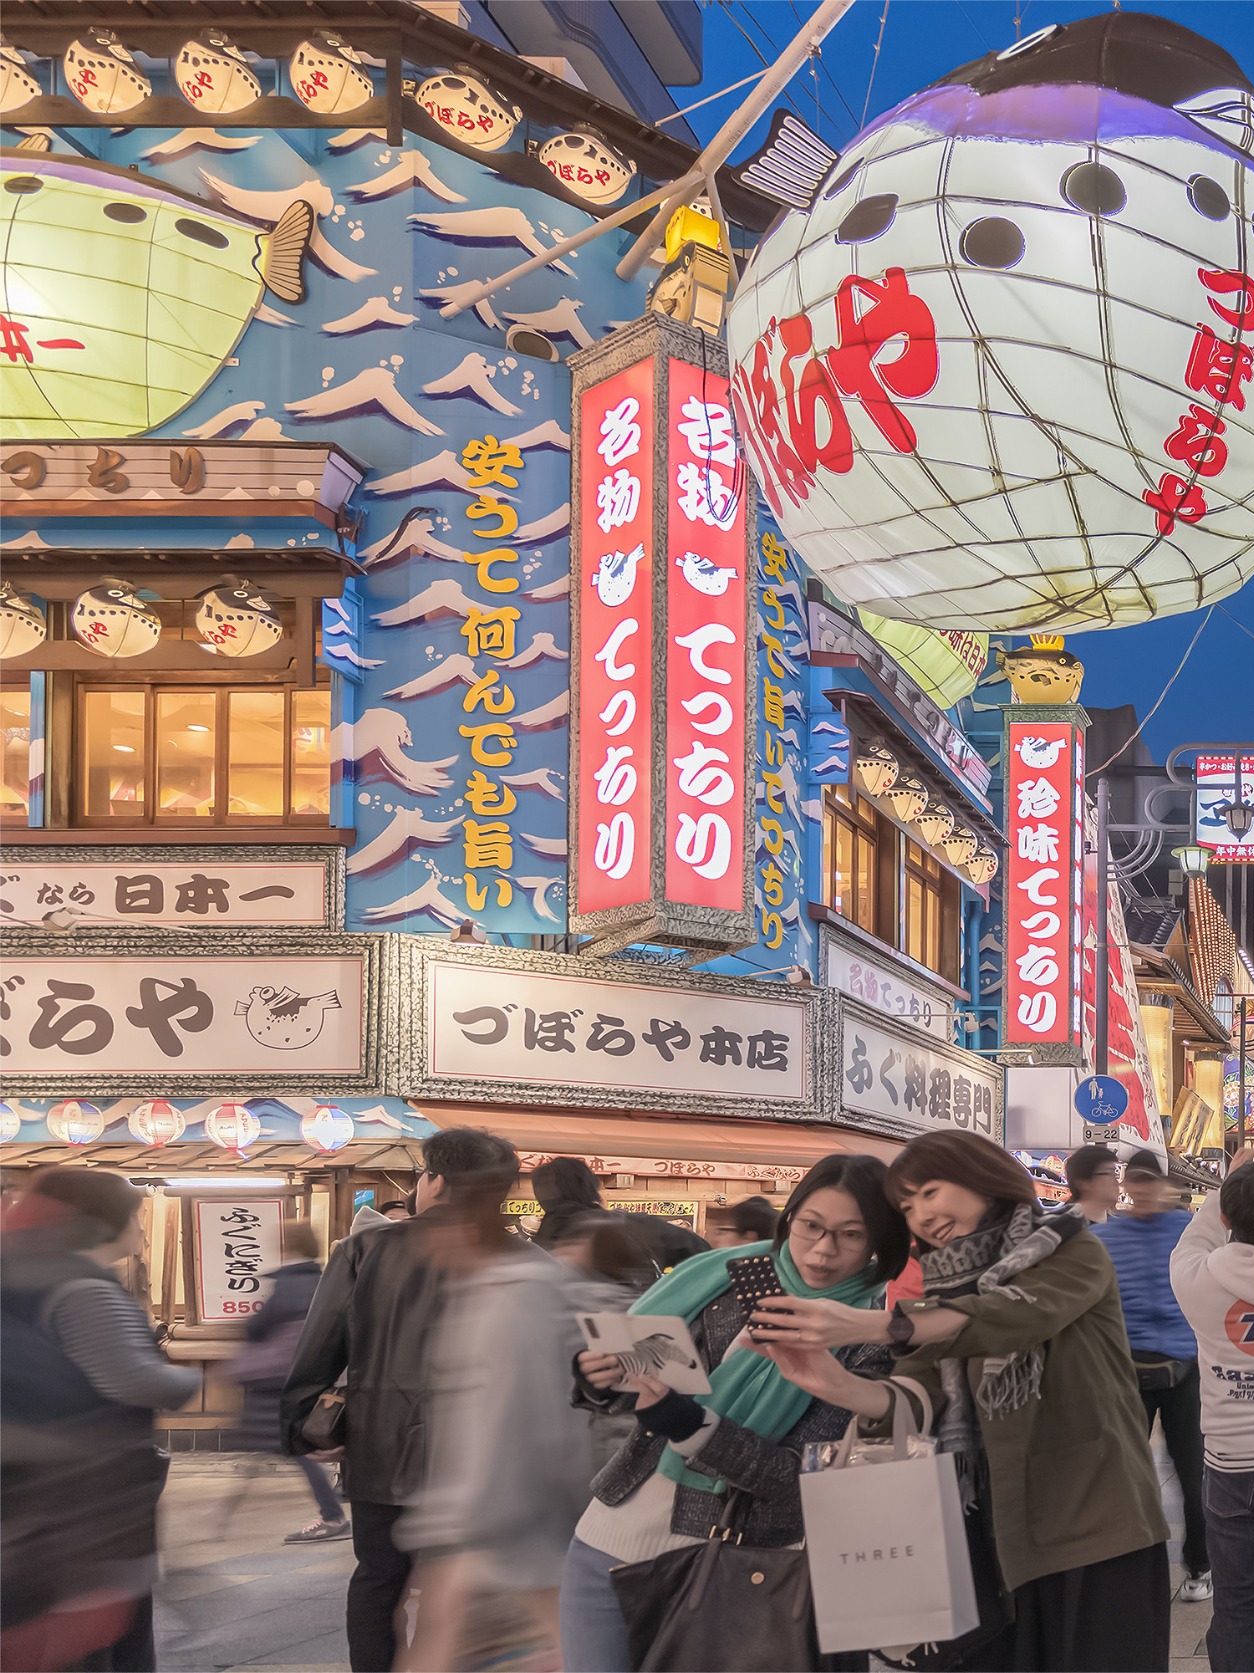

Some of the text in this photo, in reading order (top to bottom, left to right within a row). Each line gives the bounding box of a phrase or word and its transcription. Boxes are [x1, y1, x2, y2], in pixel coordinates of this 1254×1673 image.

[593, 397, 641, 880] 名物 てっちり
[674, 395, 739, 880] 名物 てっちり
[115, 874, 296, 915] 日本一
[1017, 777, 1062, 1034] 珍味てっちり
[0, 975, 214, 1058] らや
[453, 1003, 790, 1072] づぼらや本店
[846, 1034, 992, 1135] ふぐ料理専門
[1085, 1130, 1118, 1140] 9-22
[840, 1544, 915, 1565] THREE
